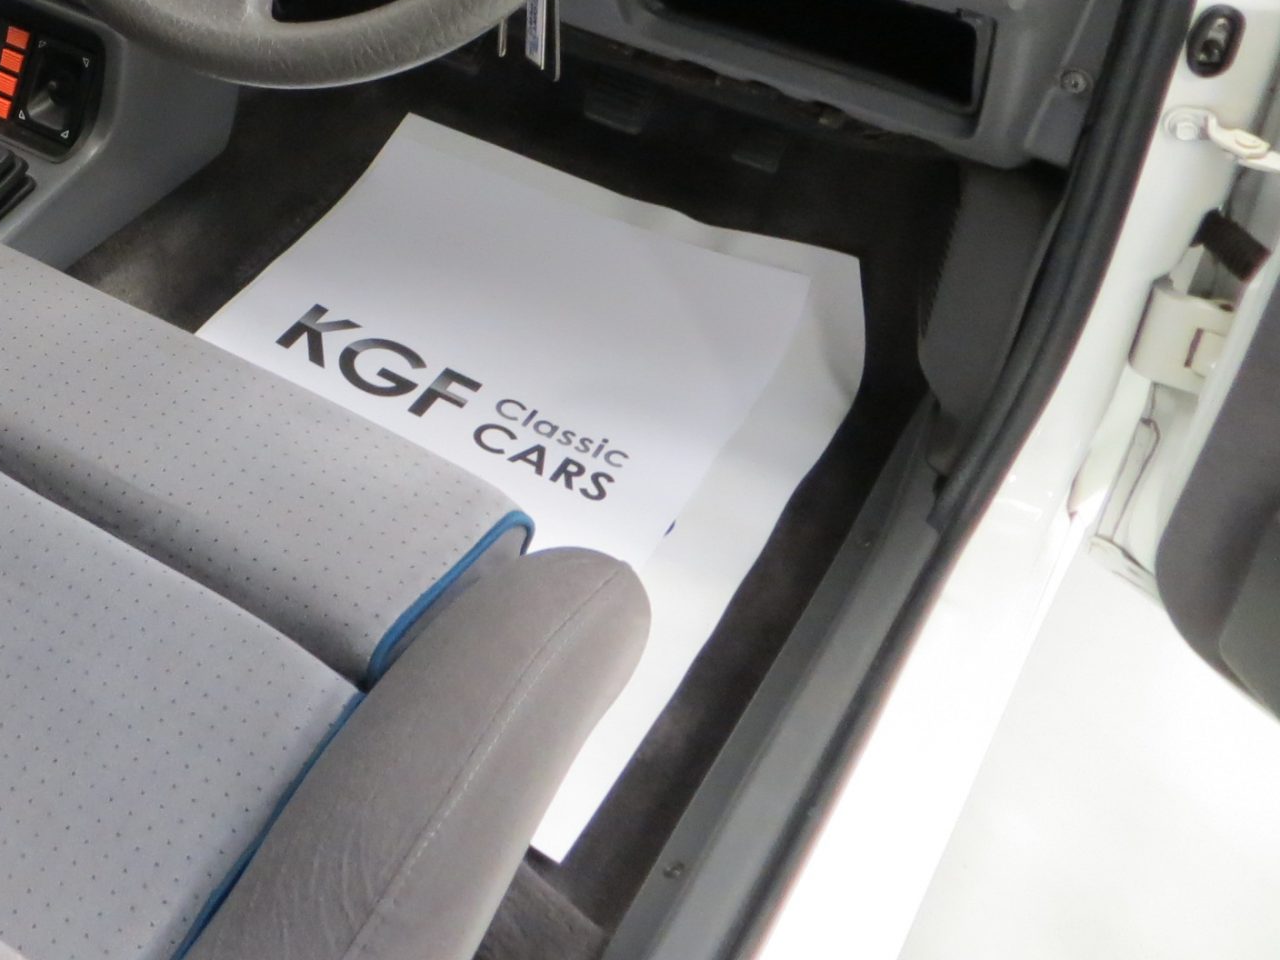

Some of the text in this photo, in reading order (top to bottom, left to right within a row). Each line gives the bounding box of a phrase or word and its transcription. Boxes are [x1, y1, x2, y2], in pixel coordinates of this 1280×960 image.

[275, 303, 629, 468] KGF Classic
[472, 423, 615, 501] CARS
